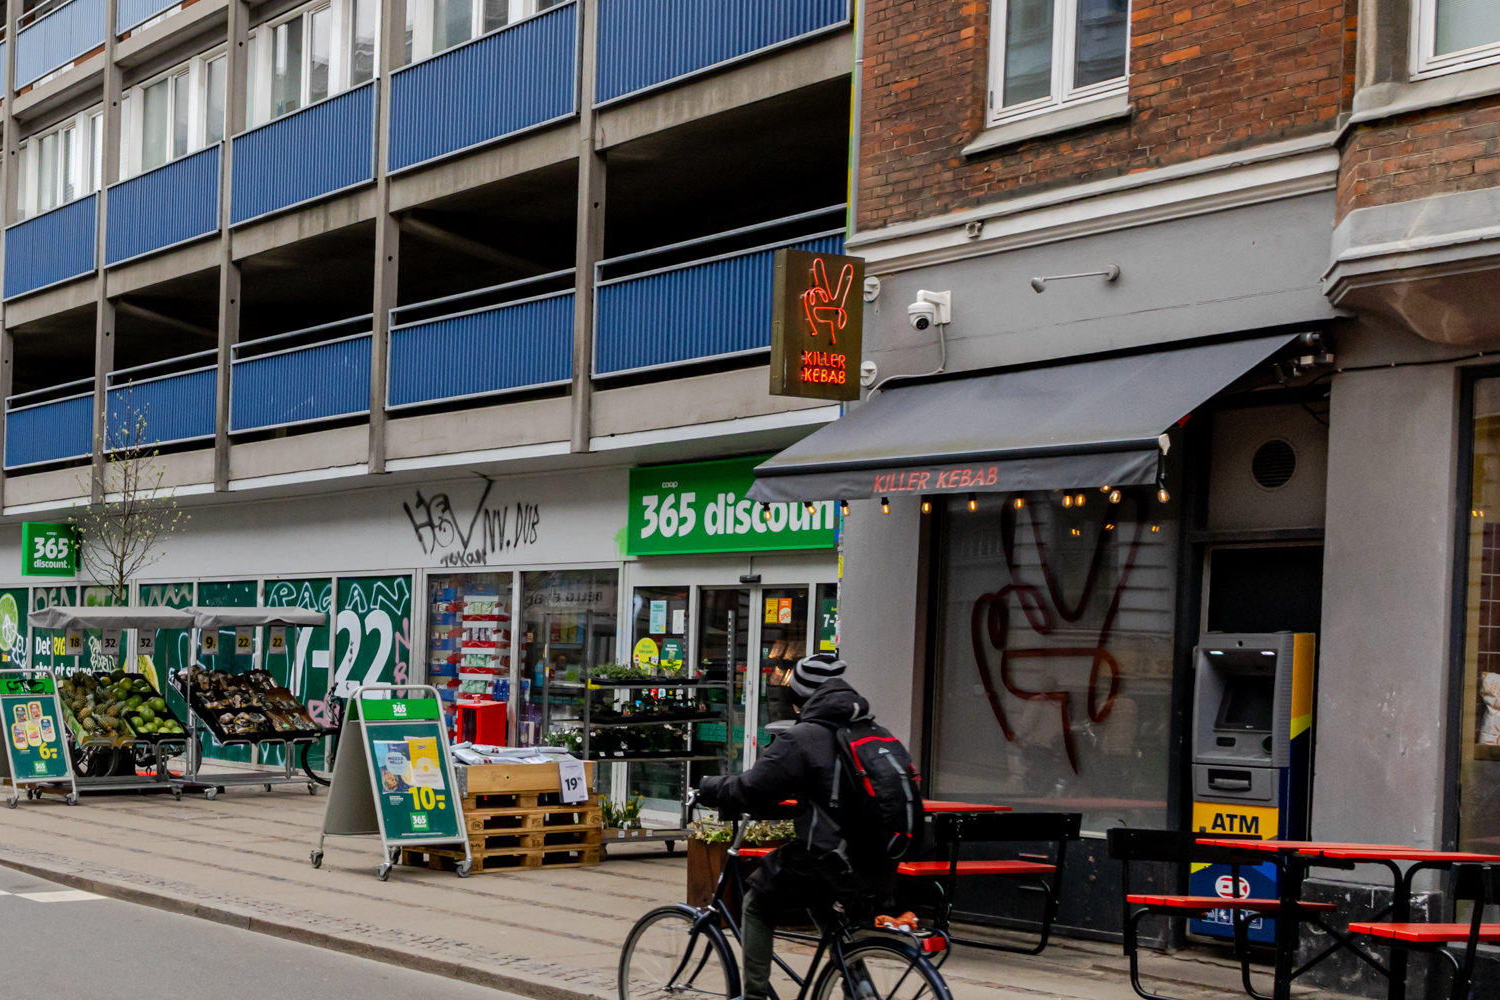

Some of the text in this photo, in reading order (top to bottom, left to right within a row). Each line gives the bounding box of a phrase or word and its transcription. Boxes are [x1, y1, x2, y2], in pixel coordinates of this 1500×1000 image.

[803, 350, 846, 369] KILLER
[803, 368, 846, 384] KEBAB
[873, 466, 998, 493] KILLER KEBAB
[641, 492, 835, 539] 365 discoun
[33, 537, 69, 559] 365
[33, 559, 67, 569] discount
[35, 636, 50, 655] Det
[392, 704, 407, 713] 365
[412, 815, 427, 825] 365
[1211, 813, 1260, 834] ATM
